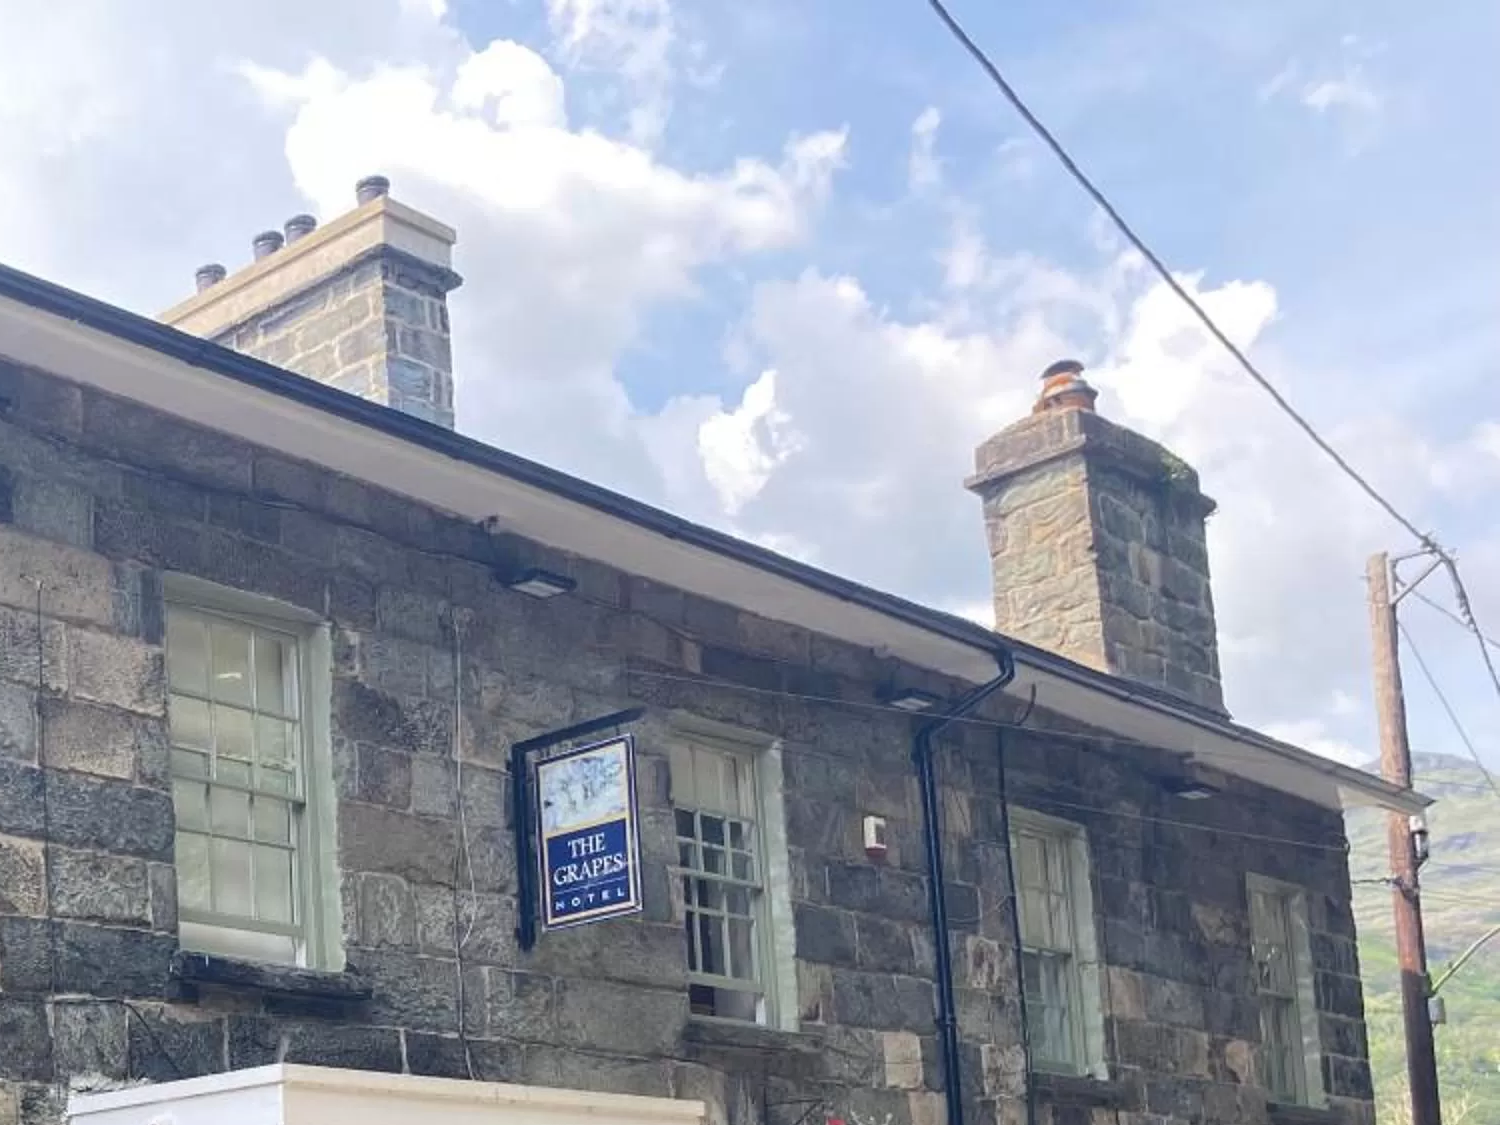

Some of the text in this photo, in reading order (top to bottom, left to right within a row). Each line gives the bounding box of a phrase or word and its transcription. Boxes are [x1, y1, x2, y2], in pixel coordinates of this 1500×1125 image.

[568, 832, 605, 858] THE
[553, 853, 624, 886] GRAPES
[555, 888, 624, 910] HOTEL
